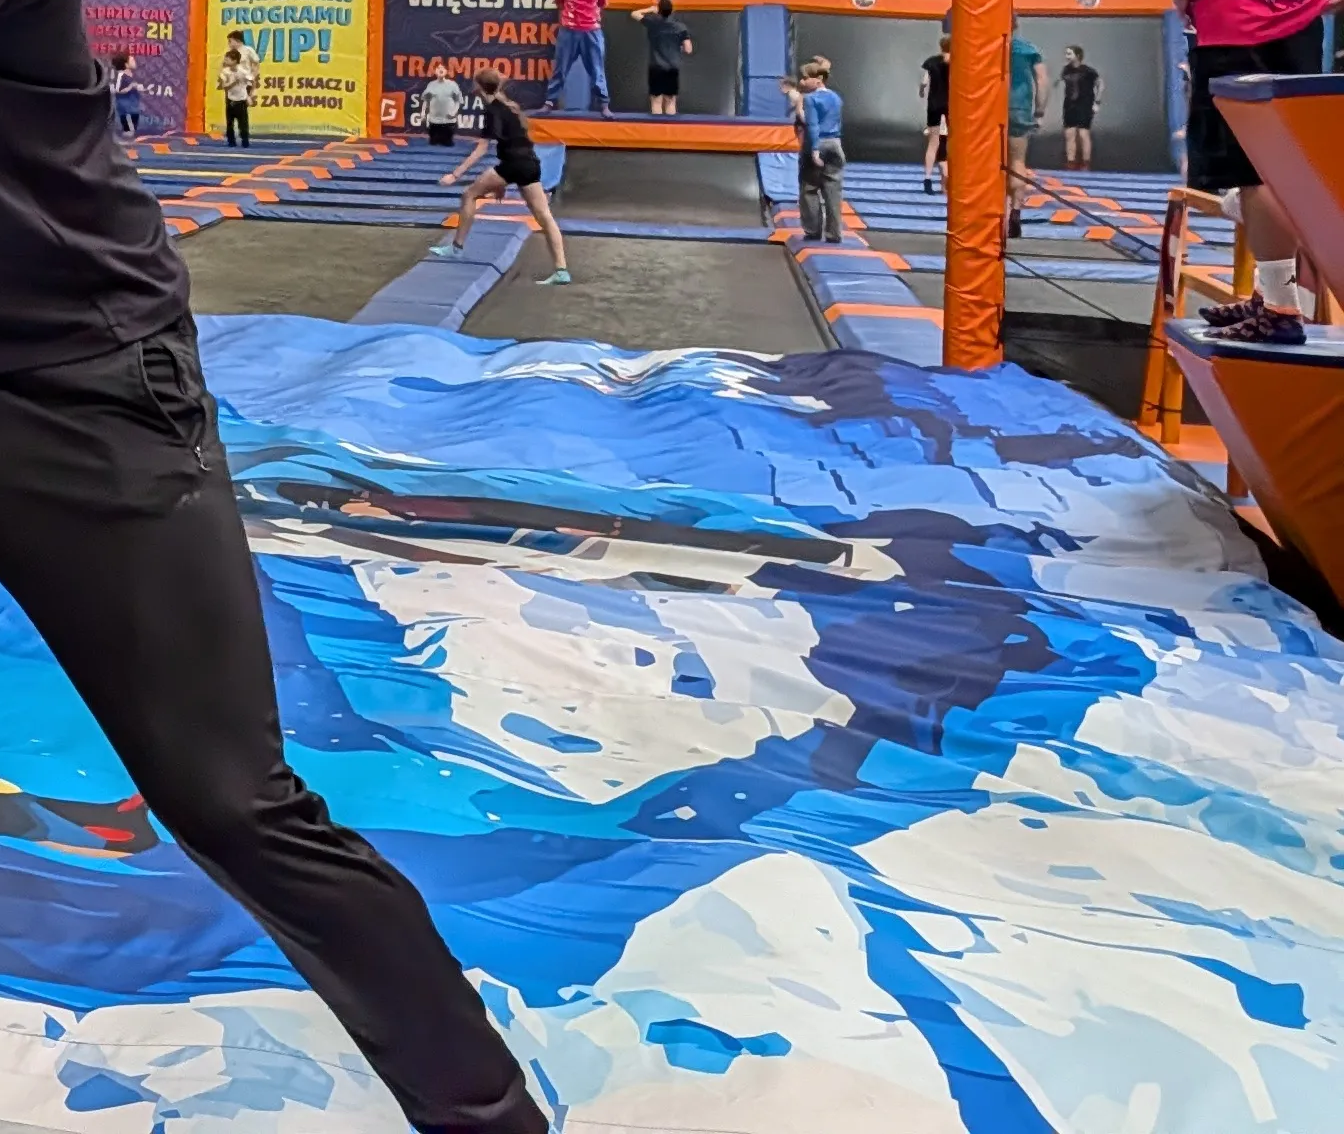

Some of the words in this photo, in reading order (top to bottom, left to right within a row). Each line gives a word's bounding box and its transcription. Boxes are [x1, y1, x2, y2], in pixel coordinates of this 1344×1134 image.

[221, 5, 352, 26] PROGRAMU
[146, 22, 173, 40] 2H
[482, 21, 559, 45] PARK
[242, 28, 332, 63] VIP!
[264, 76, 286, 92] SIĘ
[297, 77, 342, 90] SKACZ
[345, 80, 356, 92] U
[260, 95, 279, 107] ZA
[282, 95, 344, 110] DARMO!
